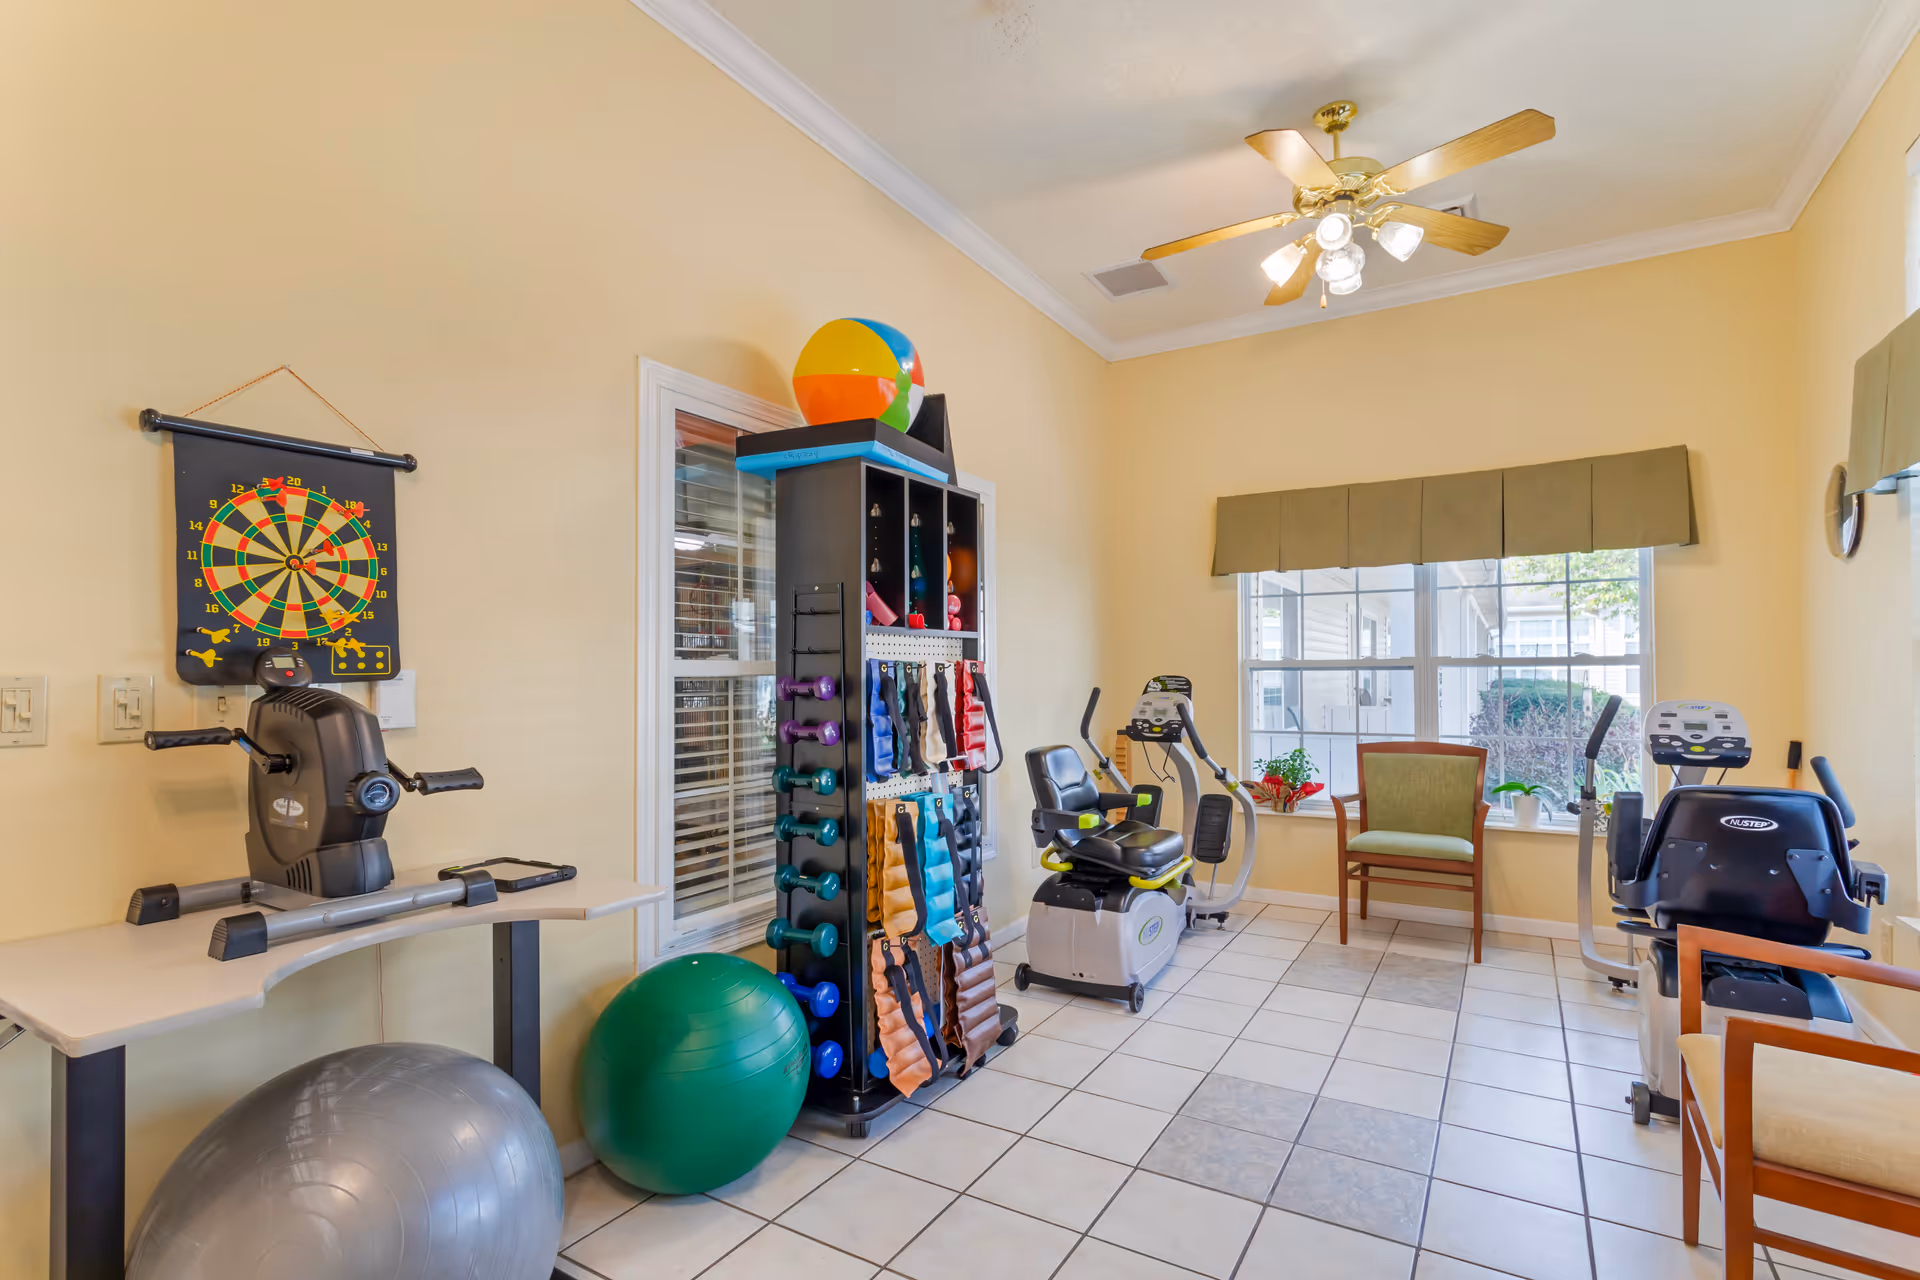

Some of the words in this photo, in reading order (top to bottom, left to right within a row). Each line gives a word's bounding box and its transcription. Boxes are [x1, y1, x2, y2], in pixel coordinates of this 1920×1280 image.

[262, 477, 269, 485] 5
[286, 476, 301, 486] 20
[231, 484, 244, 493] 12
[321, 486, 326, 494] 1
[210, 500, 217, 508] 9
[345, 500, 356, 509] 18
[189, 521, 203, 530] 14
[363, 520, 371, 529] 4
[377, 543, 387, 551] 13
[187, 551, 197, 560] 11
[381, 568, 387, 576] 6
[195, 578, 202, 587] 8
[375, 590, 387, 598] 10
[205, 604, 219, 613] 16
[363, 611, 374, 619] 15
[233, 624, 240, 633] 7
[345, 628, 351, 636] 2
[257, 638, 270, 646] 19
[292, 642, 298, 650] 3
[1730, 819, 1769, 828] NUSTEP
